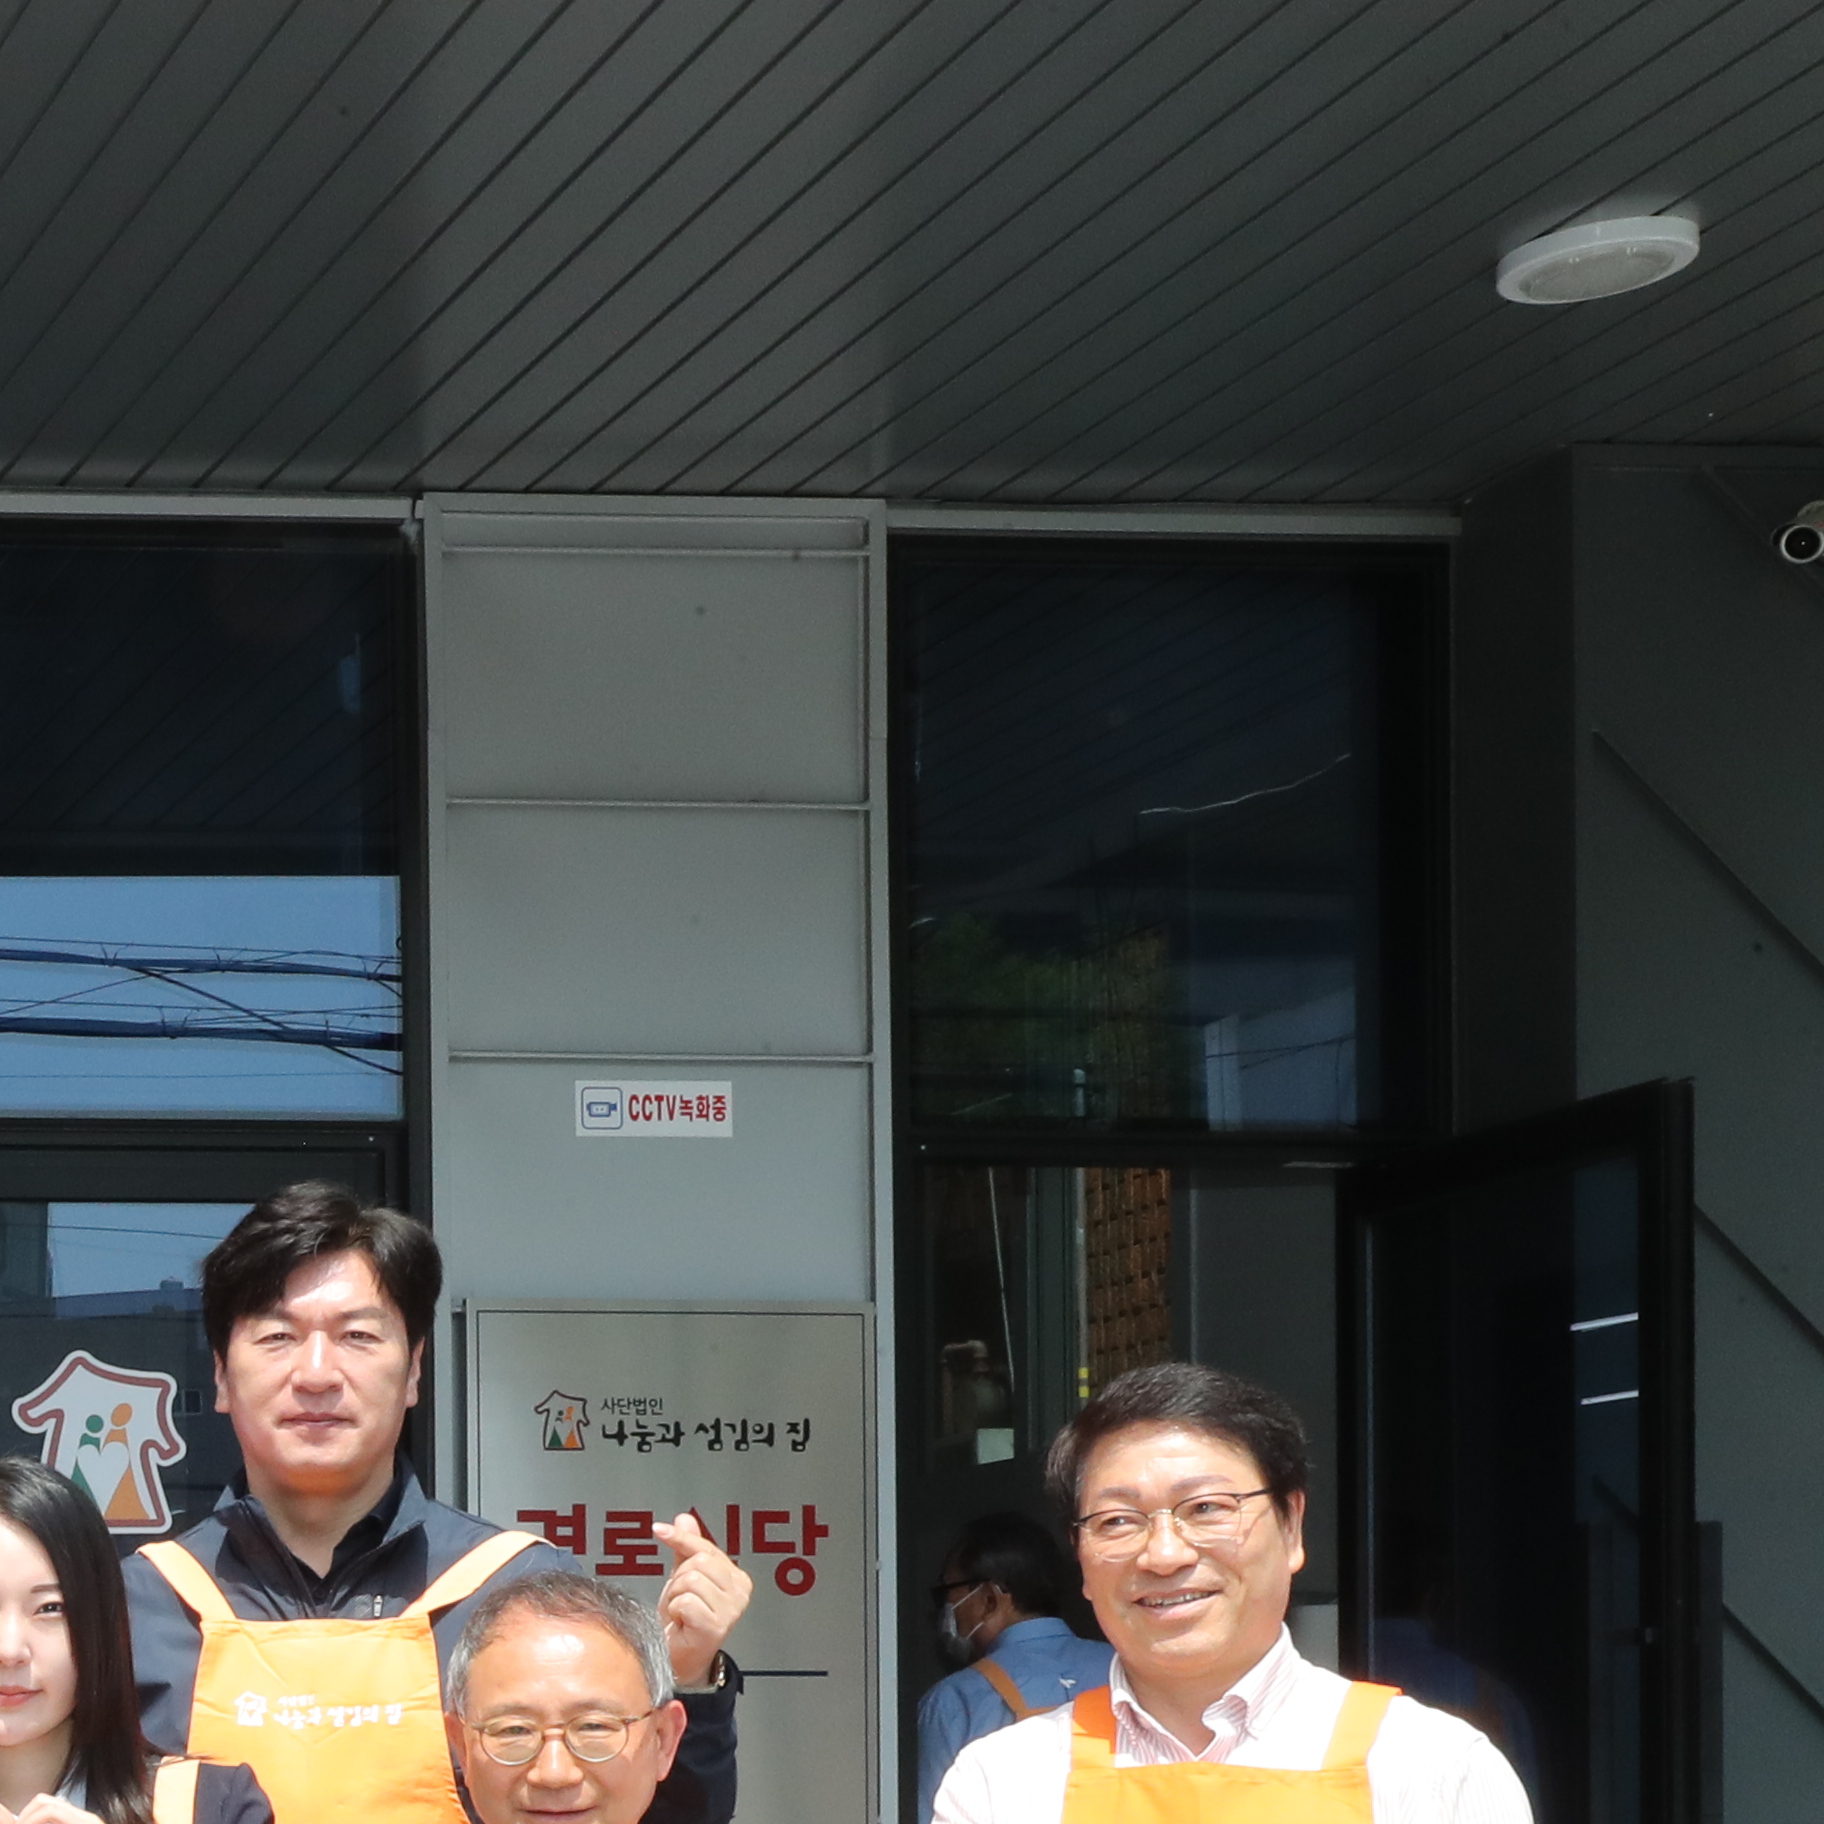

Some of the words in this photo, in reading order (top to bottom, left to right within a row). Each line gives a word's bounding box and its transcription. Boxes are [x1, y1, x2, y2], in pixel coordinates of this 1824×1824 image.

[628, 1094, 727, 1122] CCTV녹화중
[601, 1397, 663, 1416] 사단법인
[602, 1419, 685, 1453] 나눔과
[694, 1417, 774, 1452] 섬김의
[786, 1417, 810, 1452] 집
